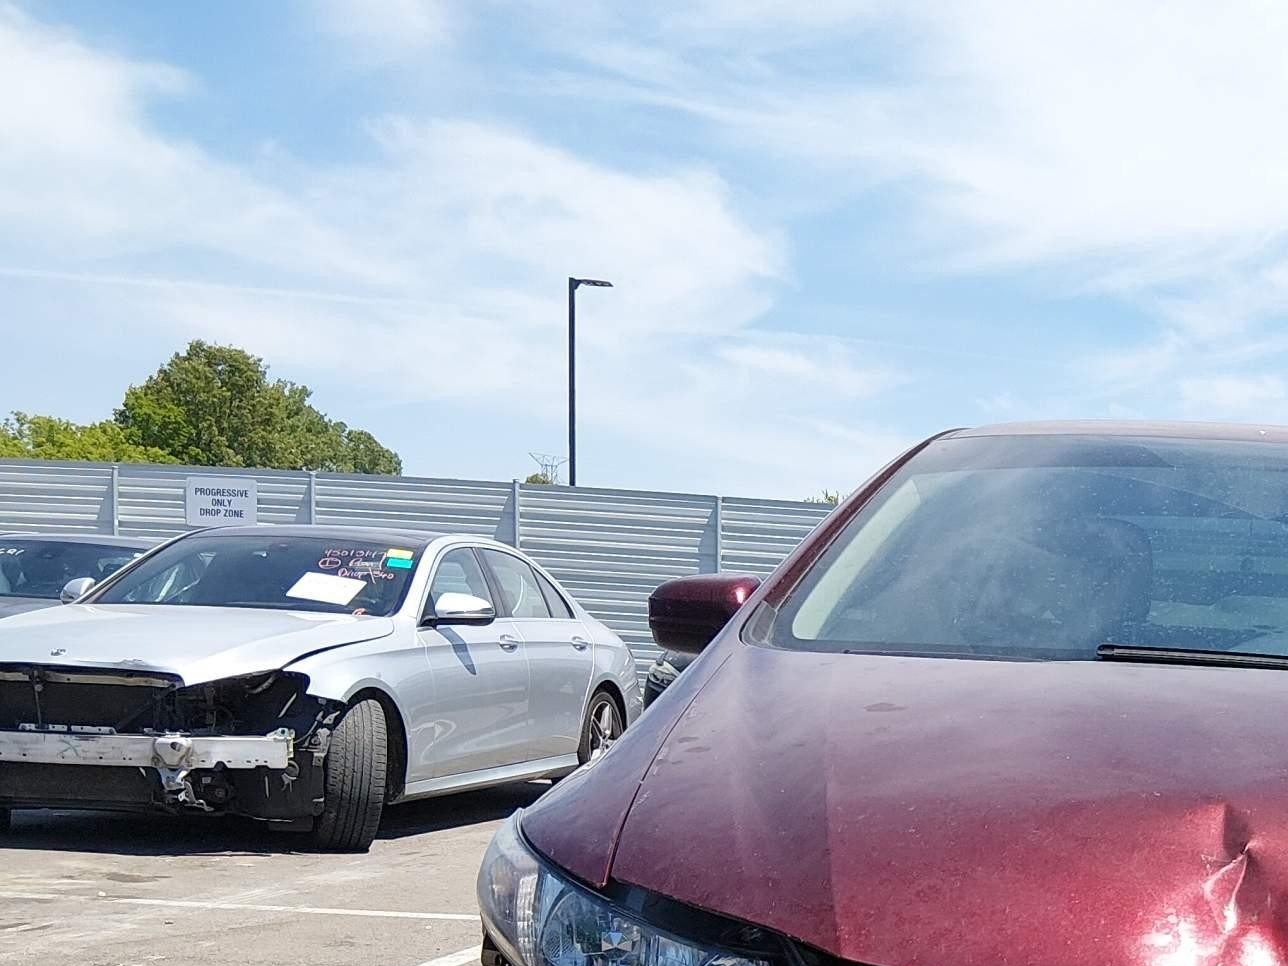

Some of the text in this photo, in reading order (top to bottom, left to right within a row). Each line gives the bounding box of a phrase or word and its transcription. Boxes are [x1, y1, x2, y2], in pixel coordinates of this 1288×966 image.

[194, 487, 249, 498] PROGRESSIVE
[211, 498, 233, 508] ONLY
[199, 508, 244, 518] DROP ZONE
